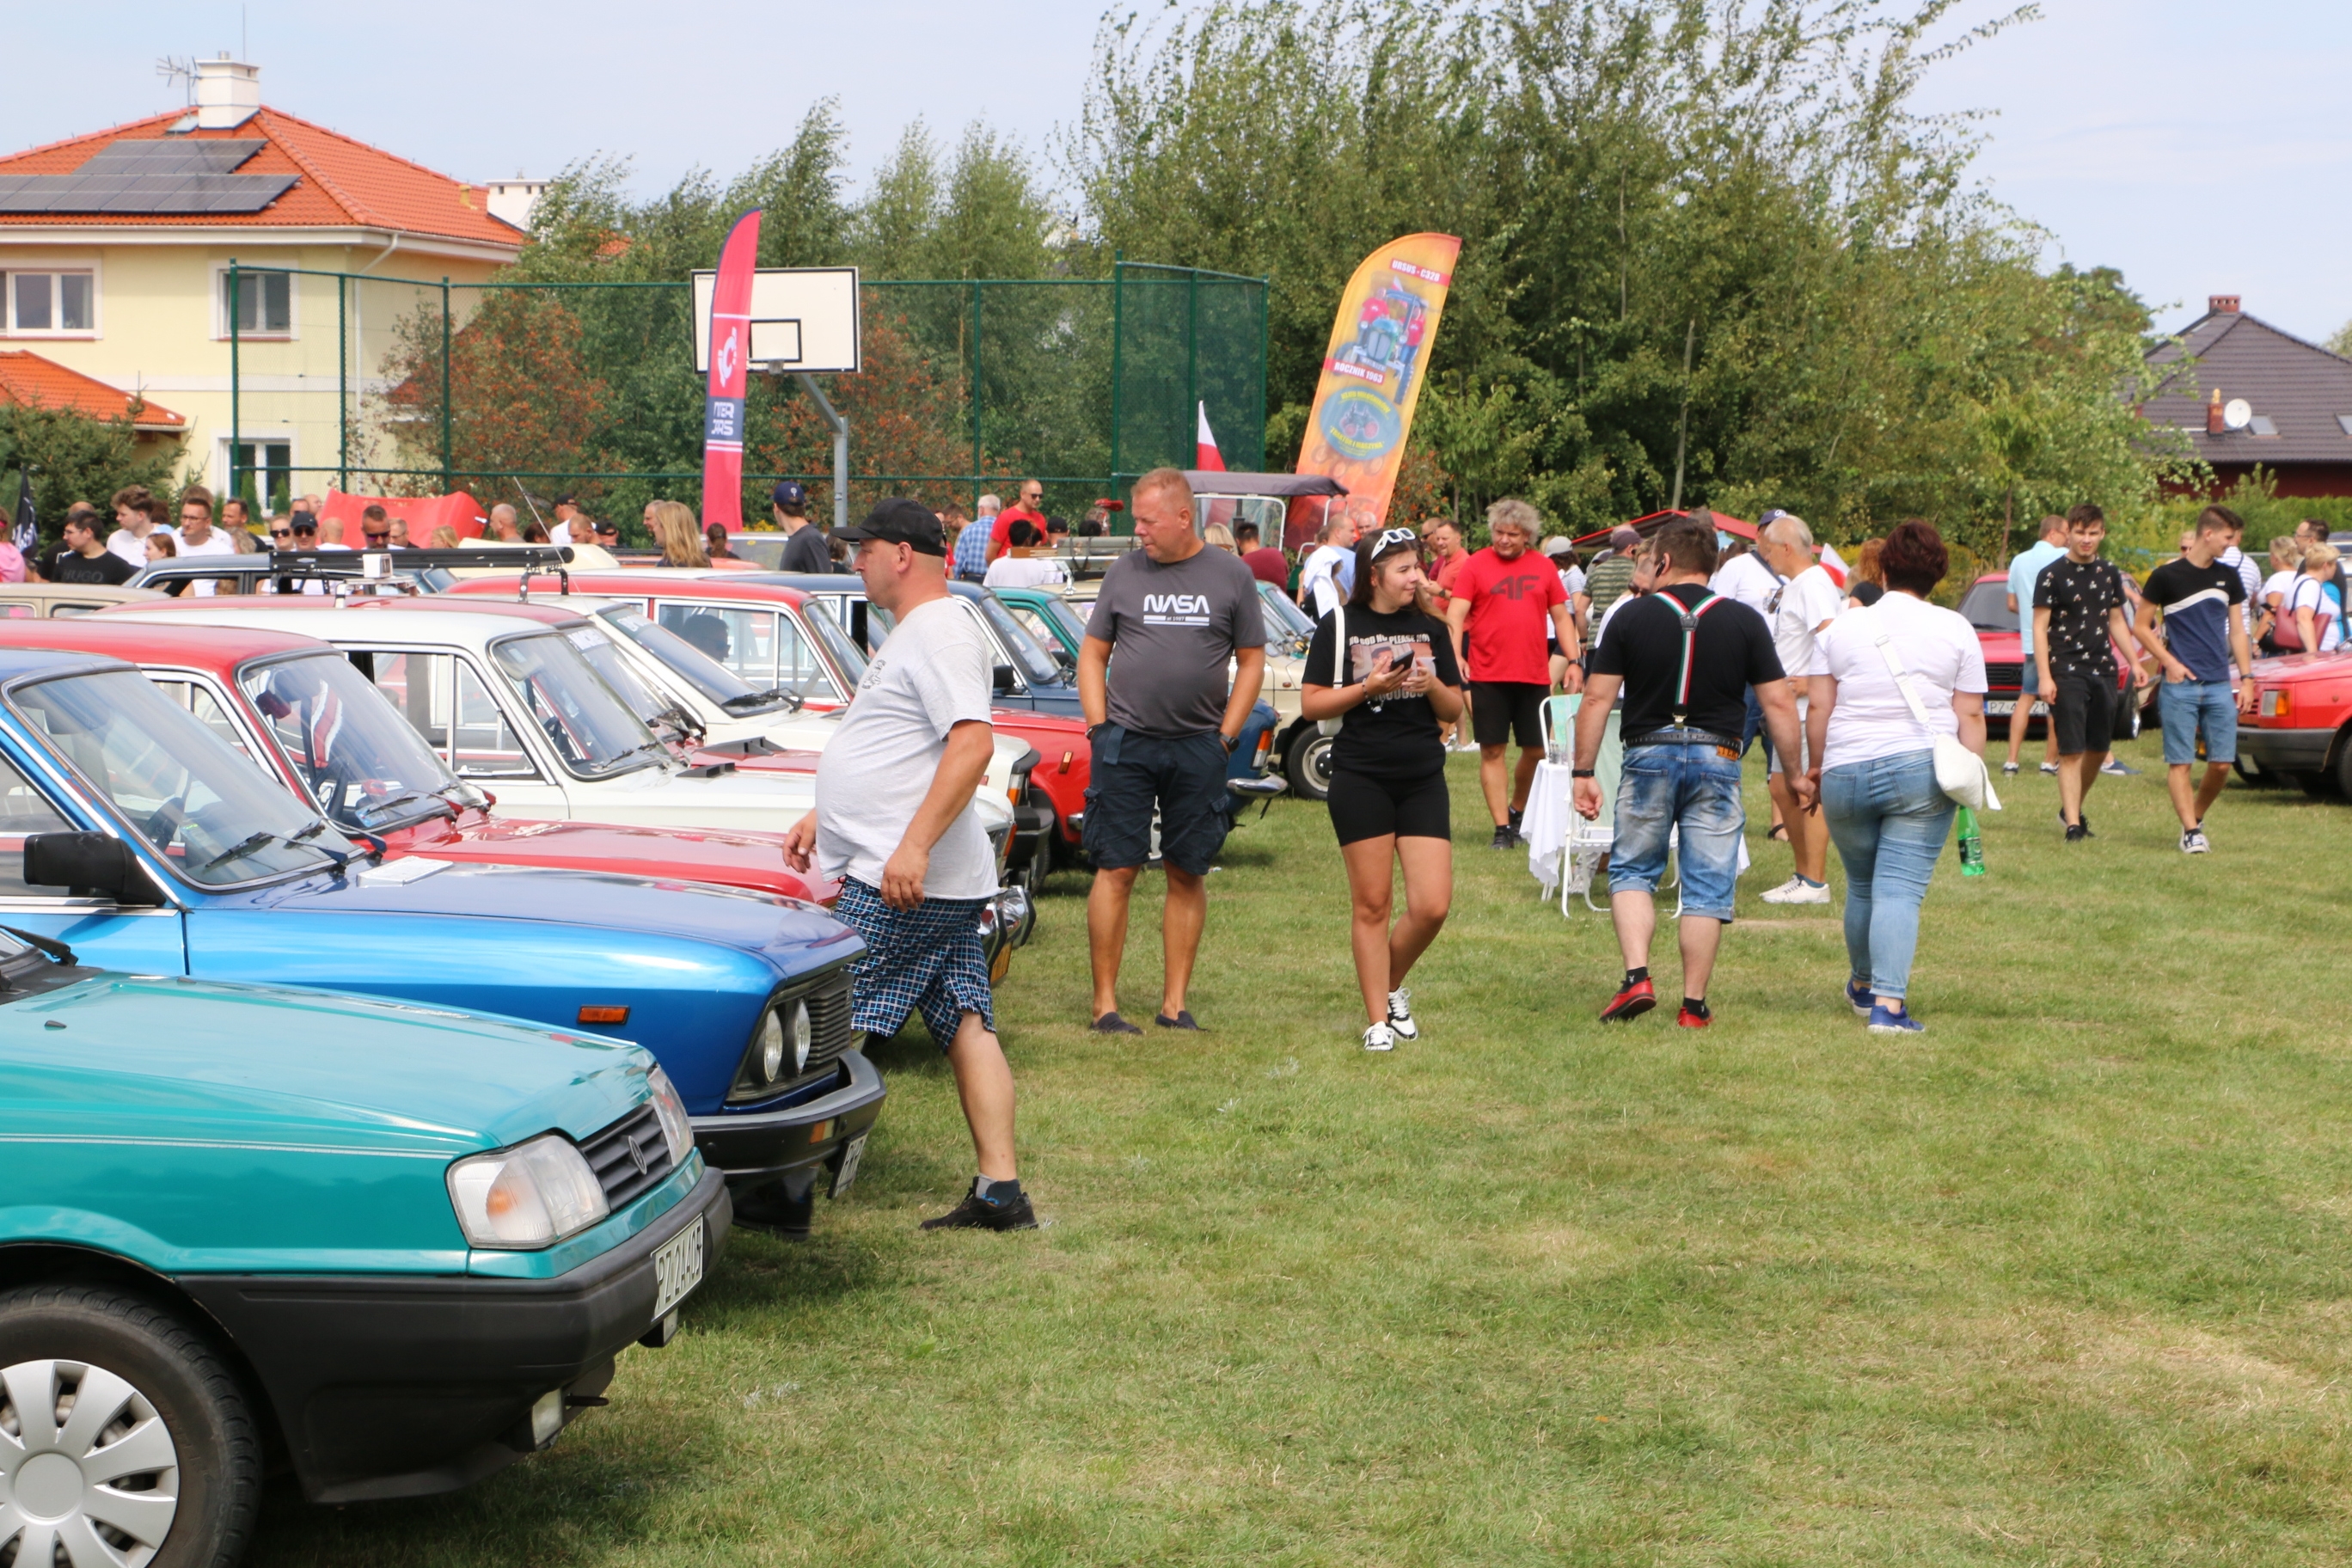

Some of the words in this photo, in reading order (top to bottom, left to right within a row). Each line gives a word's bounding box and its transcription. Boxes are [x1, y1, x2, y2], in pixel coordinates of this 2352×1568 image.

[1392, 259, 1417, 275] URSUS
[1334, 361, 1366, 378] ROCZNIK
[1490, 575, 1540, 600] 4F
[1143, 593, 1210, 614] NASA
[1349, 636, 1359, 646] NO
[1388, 634, 1416, 645] PLEASE
[1990, 701, 2005, 714] PZ
[2010, 701, 2046, 714] 421
[657, 1249, 672, 1309] PZ
